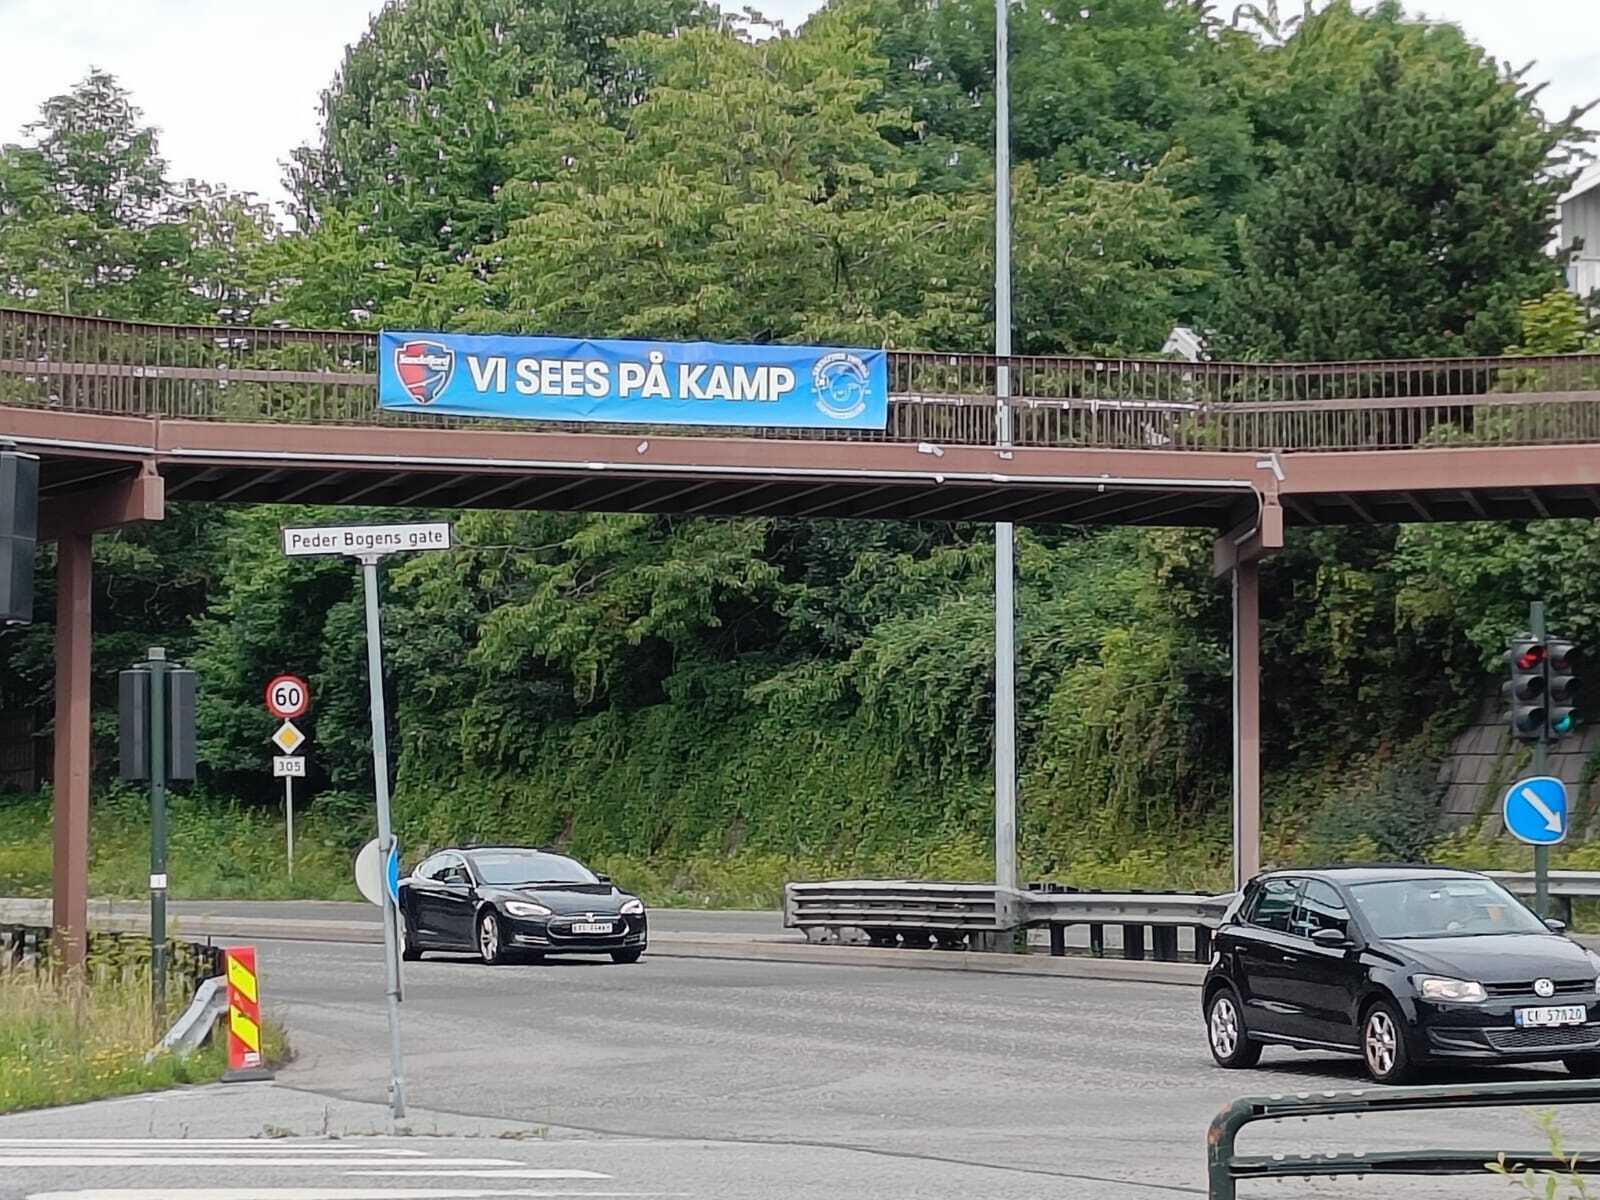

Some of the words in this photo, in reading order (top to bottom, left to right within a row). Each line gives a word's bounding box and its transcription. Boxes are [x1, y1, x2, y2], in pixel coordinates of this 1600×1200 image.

[467, 356, 506, 393] VI
[515, 358, 610, 397] SEES
[619, 351, 670, 398] PÅ
[679, 364, 795, 402] KAMP
[292, 533, 337, 548] Peder
[344, 532, 402, 549] Bogens
[409, 531, 443, 547] gate
[275, 687, 300, 707] 60
[279, 761, 301, 772] 305
